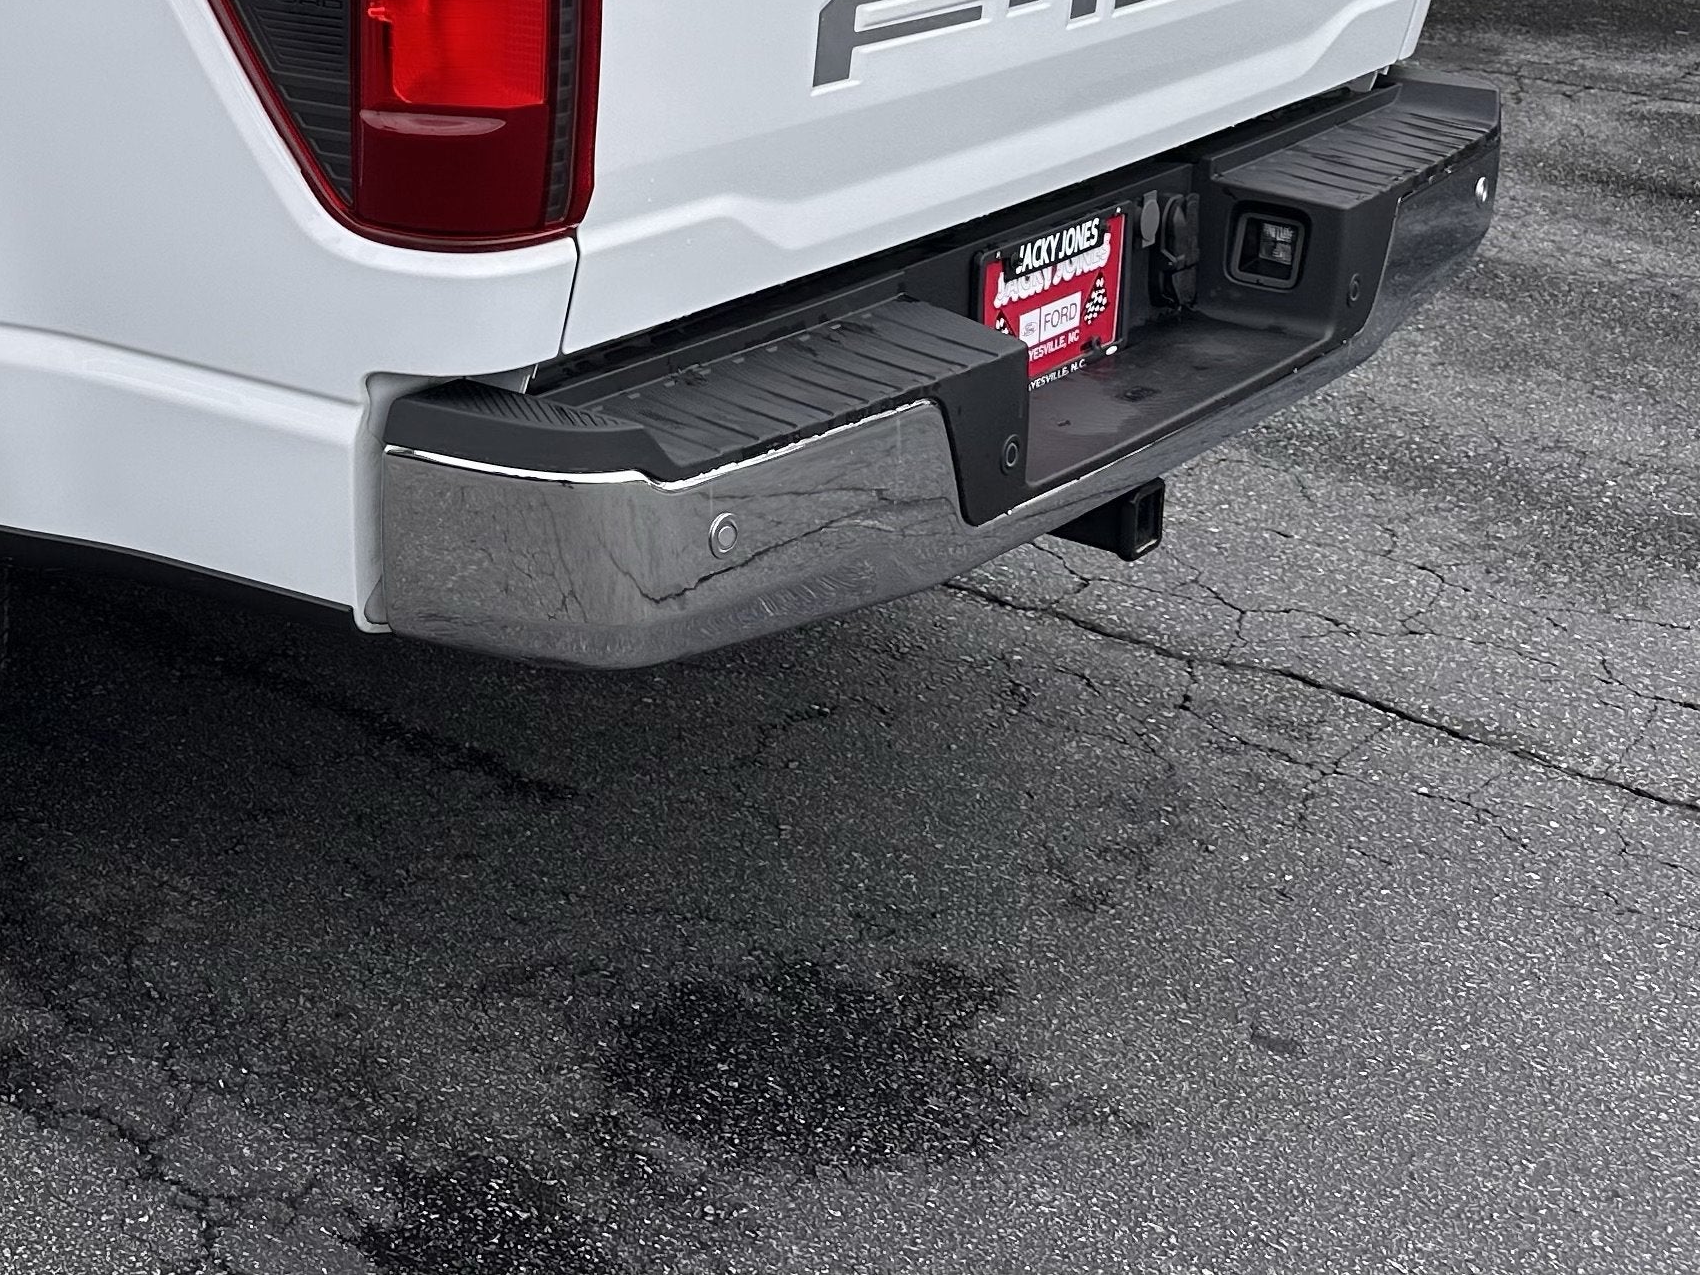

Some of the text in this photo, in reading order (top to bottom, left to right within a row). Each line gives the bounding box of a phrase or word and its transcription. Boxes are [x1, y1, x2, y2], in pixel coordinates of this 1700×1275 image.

[1015, 217, 1100, 275] JACKY JONES
[1043, 302, 1078, 332] FORD
[1028, 334, 1067, 362] YESVILLE,
